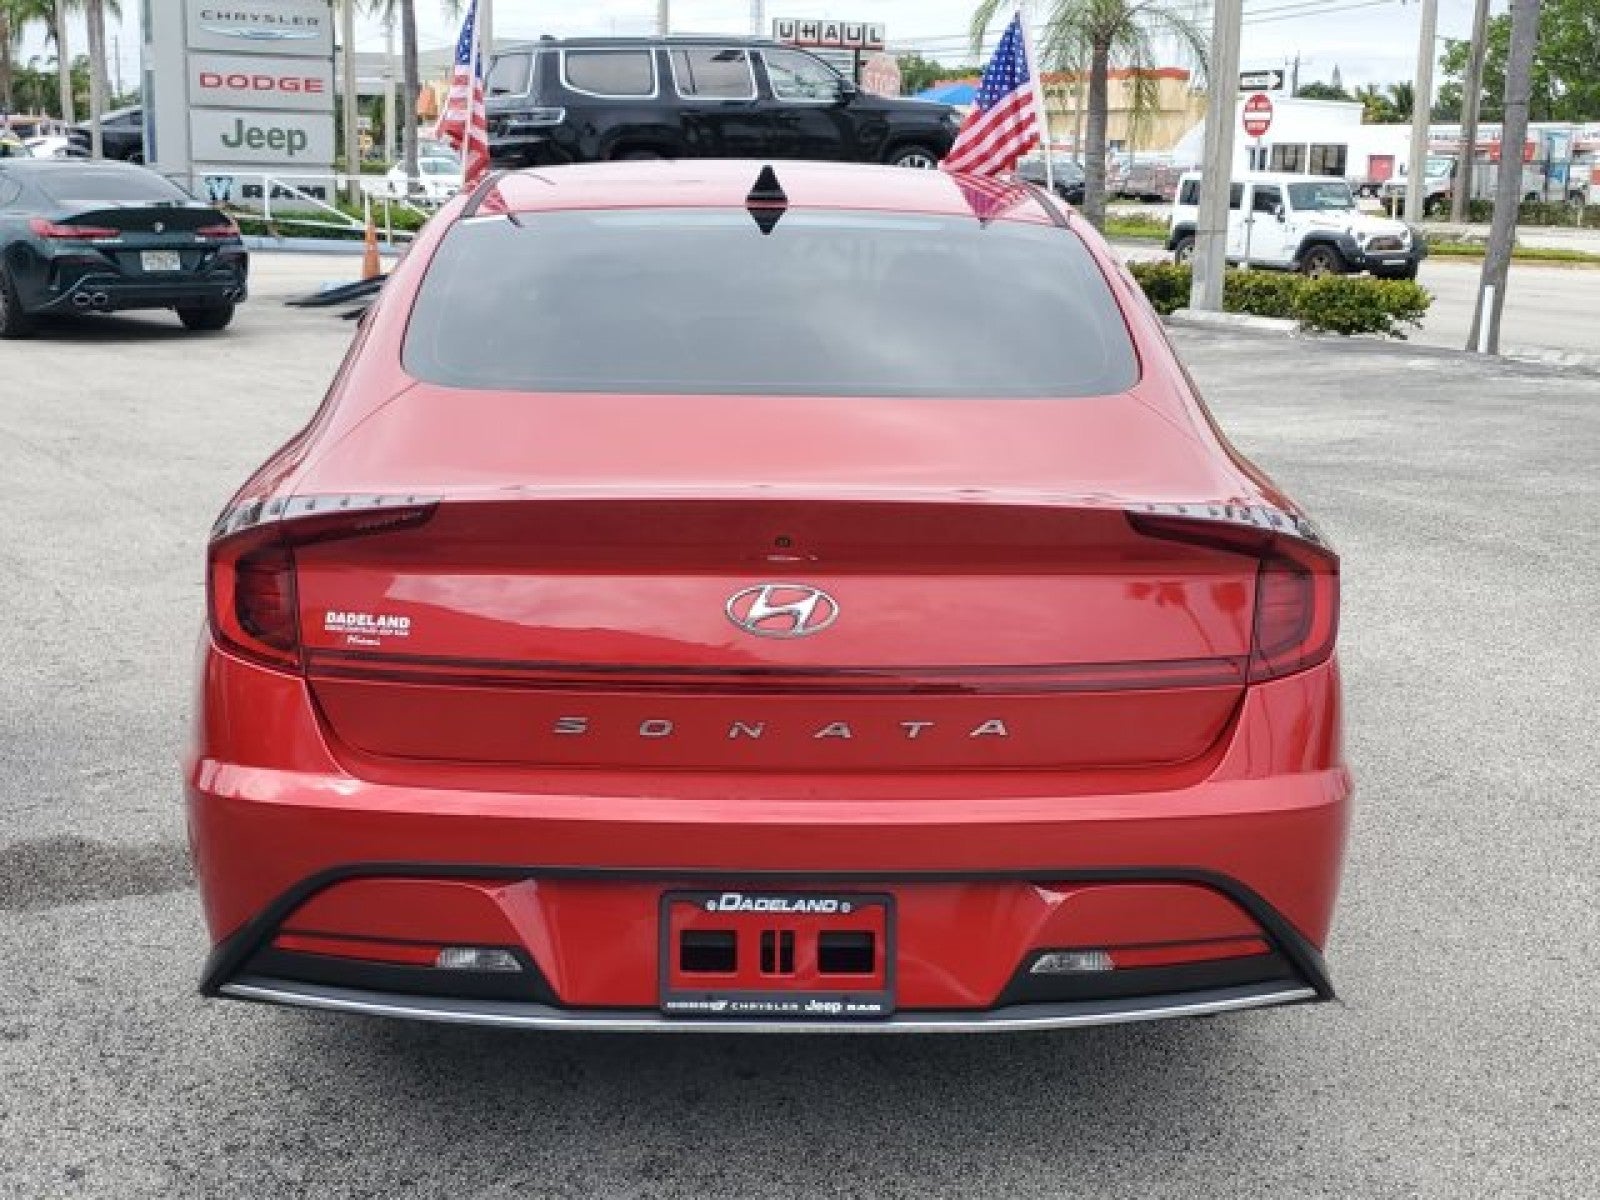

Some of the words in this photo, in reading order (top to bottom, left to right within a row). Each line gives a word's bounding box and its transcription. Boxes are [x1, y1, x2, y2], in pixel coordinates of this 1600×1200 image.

[200, 9, 320, 26] CHRYSLER
[199, 72, 325, 93] DODGE
[220, 118, 308, 156] Jeep
[241, 184, 326, 200] RAM
[325, 611, 410, 629] DADELAND
[552, 716, 1008, 739] SONATA
[805, 1000, 841, 1014] Jeep
